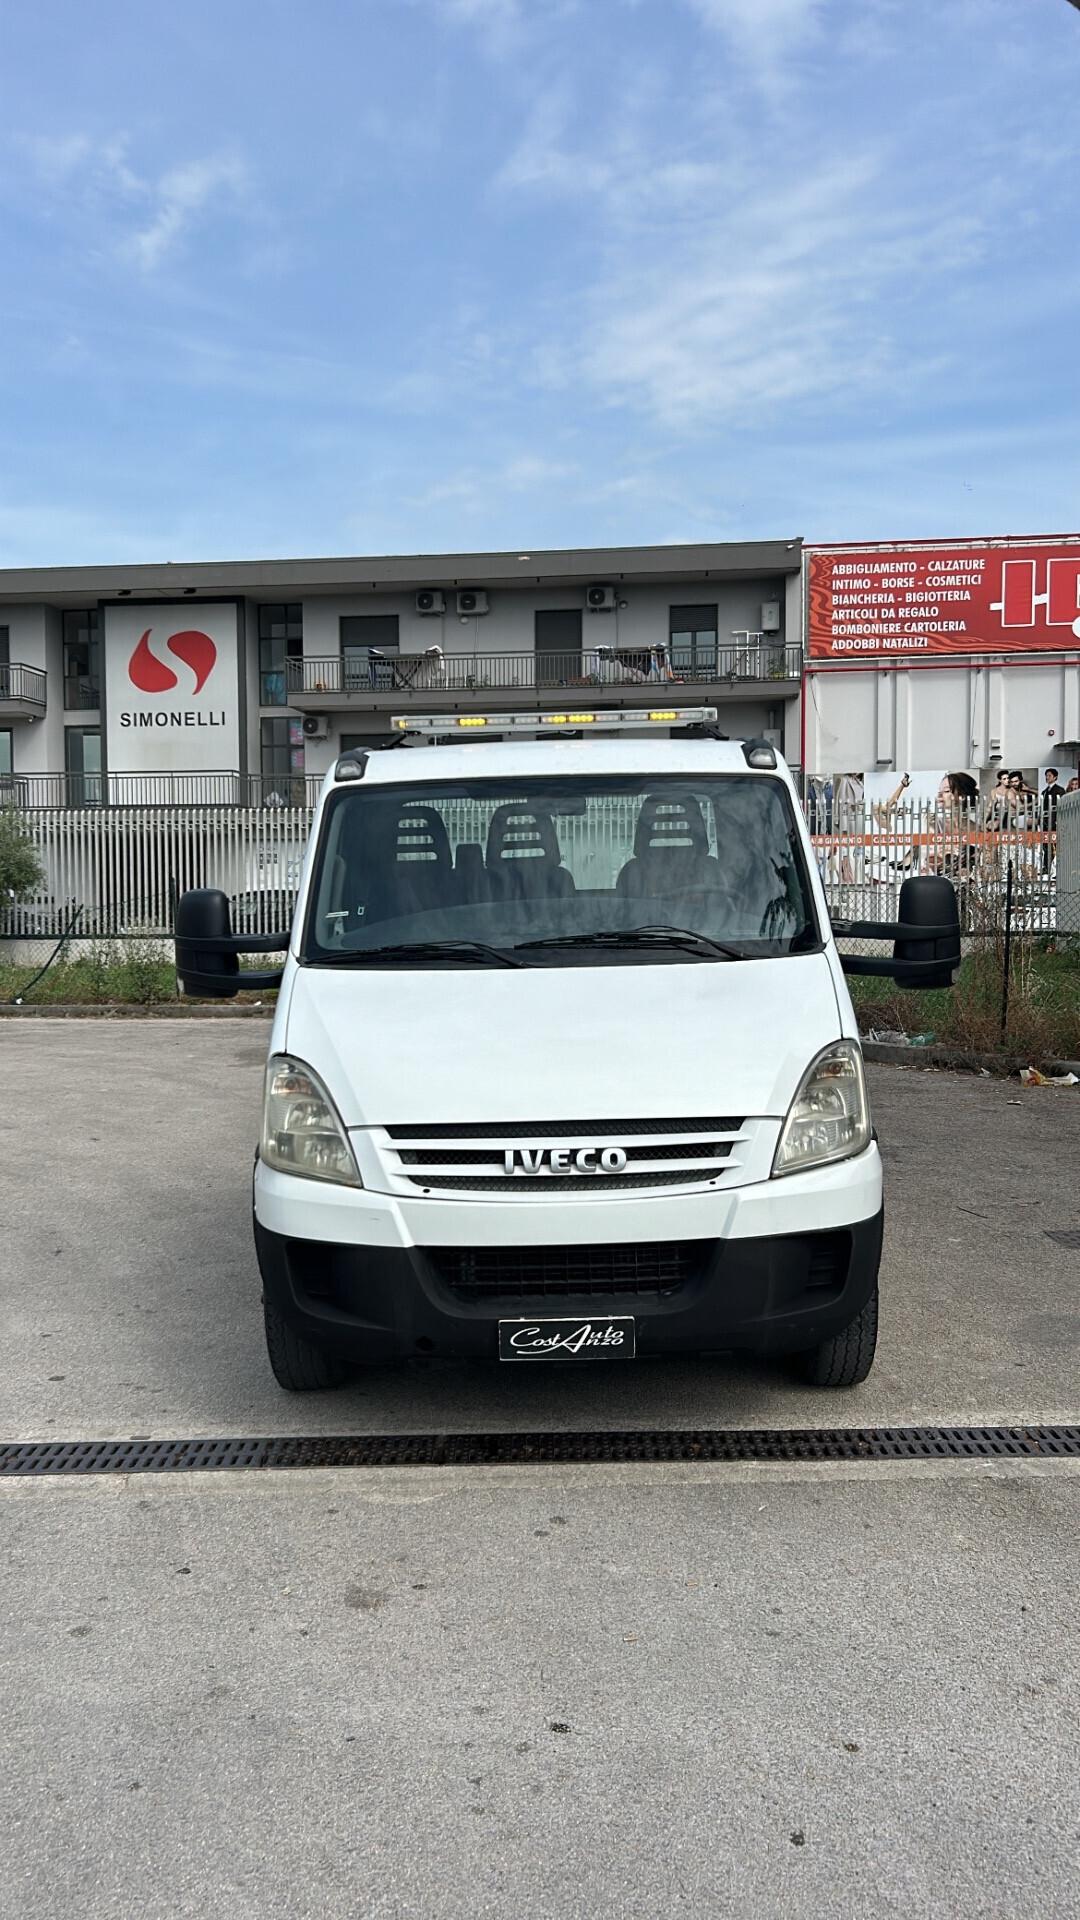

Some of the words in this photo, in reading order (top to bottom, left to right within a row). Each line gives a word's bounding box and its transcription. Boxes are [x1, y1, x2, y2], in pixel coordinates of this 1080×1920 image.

[832, 562, 917, 575] ABBIGLIAMENTO
[928, 559, 986, 571] CALZATURE
[832, 579, 871, 590] INTIMO
[881, 577, 915, 589] BORSE
[926, 575, 982, 587] COSMETICI
[832, 593, 895, 605] BIANCHERIA
[906, 591, 971, 603] BIGIOTTERIA
[832, 608, 878, 620] ARTICOLI
[881, 608, 895, 618] DA
[898, 606, 939, 618] REGALO
[832, 623, 901, 635] BOMBONIERE
[904, 621, 966, 633] CARTOLERIA
[832, 638, 880, 650] ADDOBBI
[883, 637, 928, 649] NATALIZI
[120, 712, 225, 727] SIMONELLI
[504, 1147, 627, 1175] IVECO
